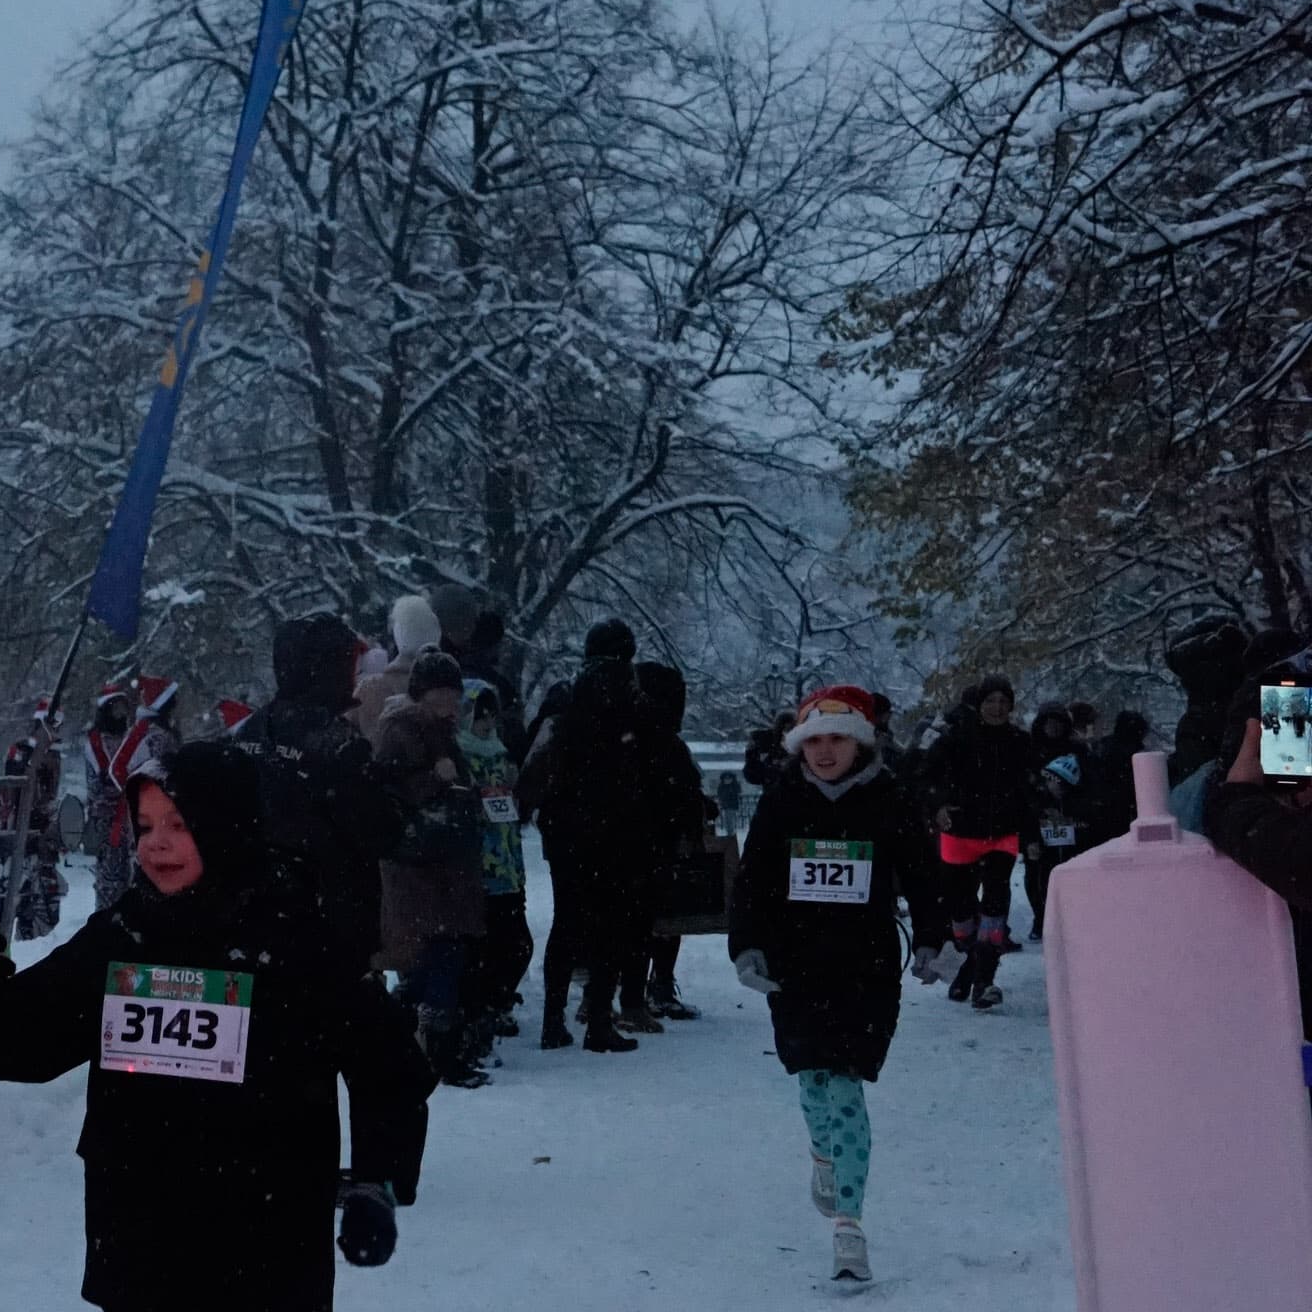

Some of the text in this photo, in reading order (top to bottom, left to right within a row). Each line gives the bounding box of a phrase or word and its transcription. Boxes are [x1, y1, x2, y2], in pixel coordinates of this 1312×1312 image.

[804, 862, 854, 886] 3121
[170, 968, 205, 985] KIDS
[120, 1003, 219, 1050] 3143
